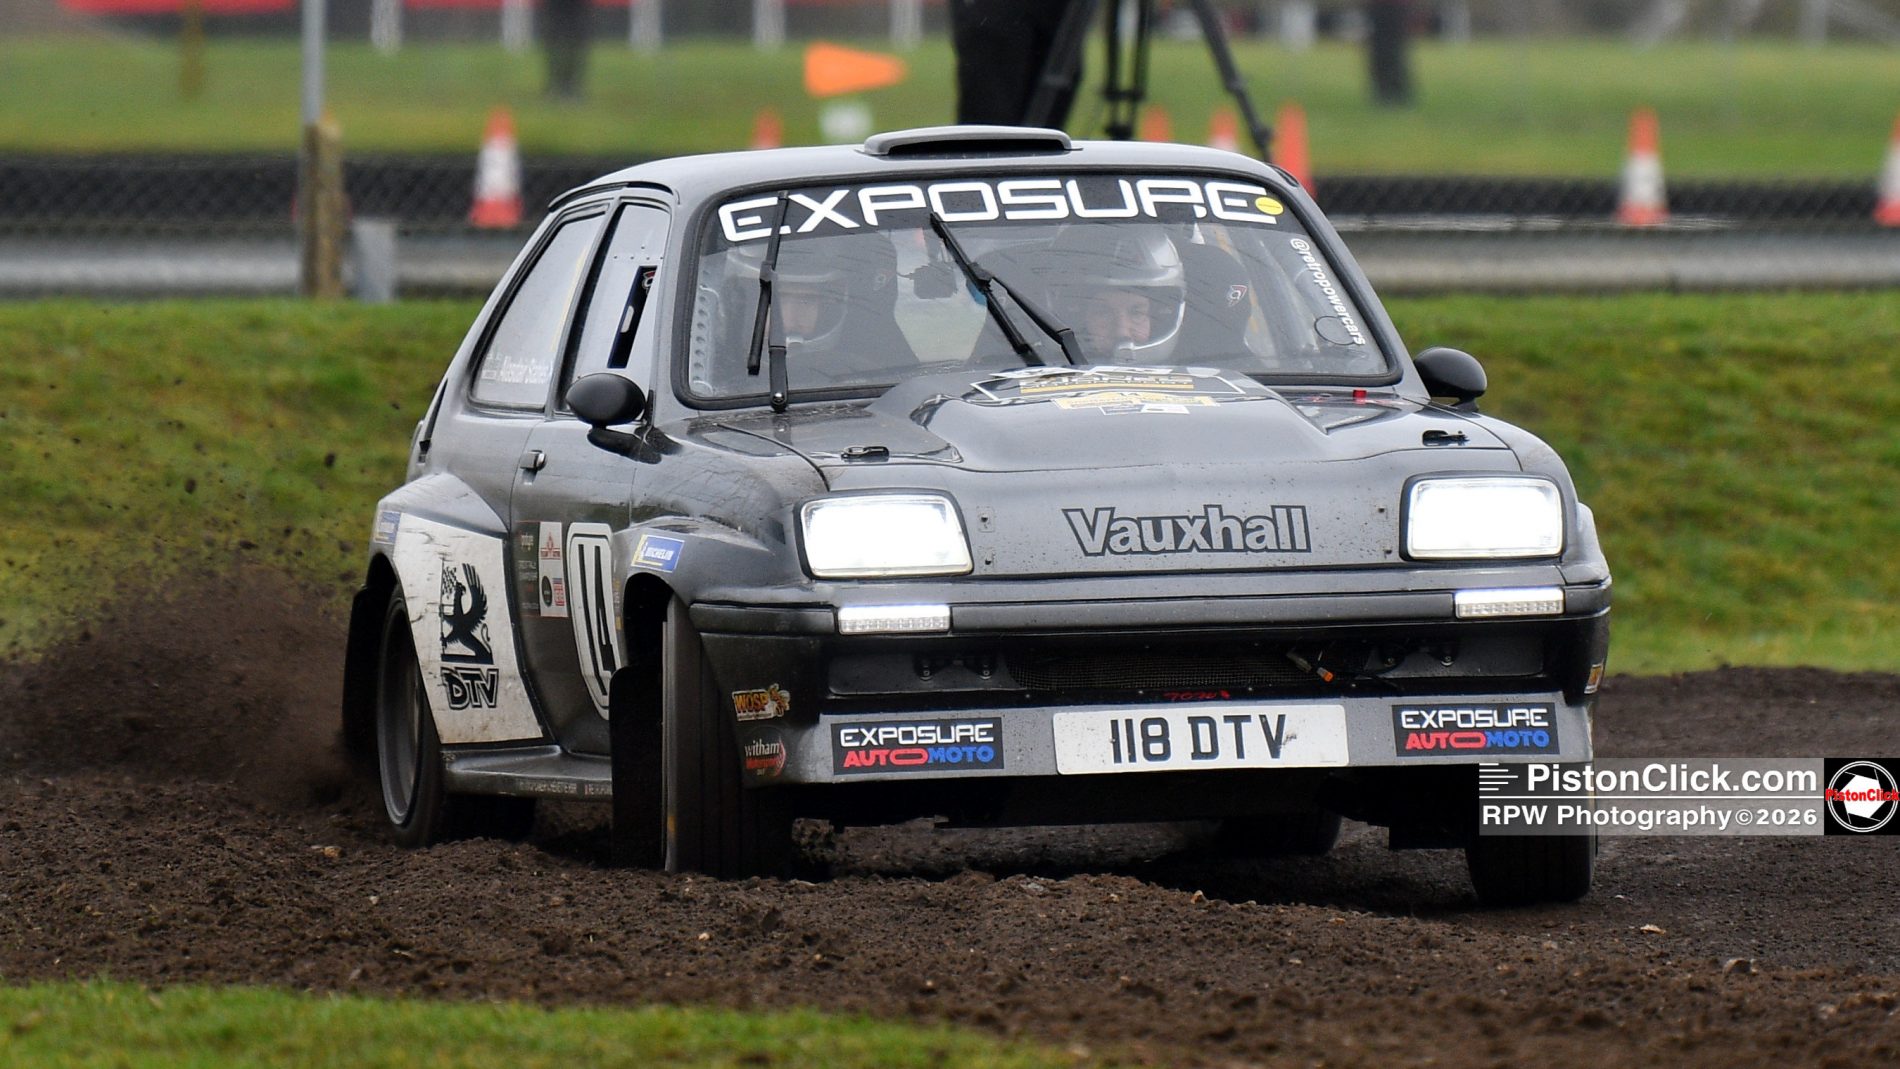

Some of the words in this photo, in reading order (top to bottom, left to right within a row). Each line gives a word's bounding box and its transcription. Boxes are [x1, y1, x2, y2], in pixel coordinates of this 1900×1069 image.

[718, 180, 1277, 242] EXPOSURE
[1290, 238, 1366, 345] @retropowercars
[1061, 504, 1312, 557] Vauxhall
[440, 666, 499, 711] DTV
[734, 691, 770, 714] WOSP
[840, 723, 994, 747] EXPOSURE
[1110, 716, 1172, 764] 118
[1187, 713, 1287, 760] DTV
[1400, 708, 1549, 729] EXPOSURE
[744, 738, 780, 757] witham
